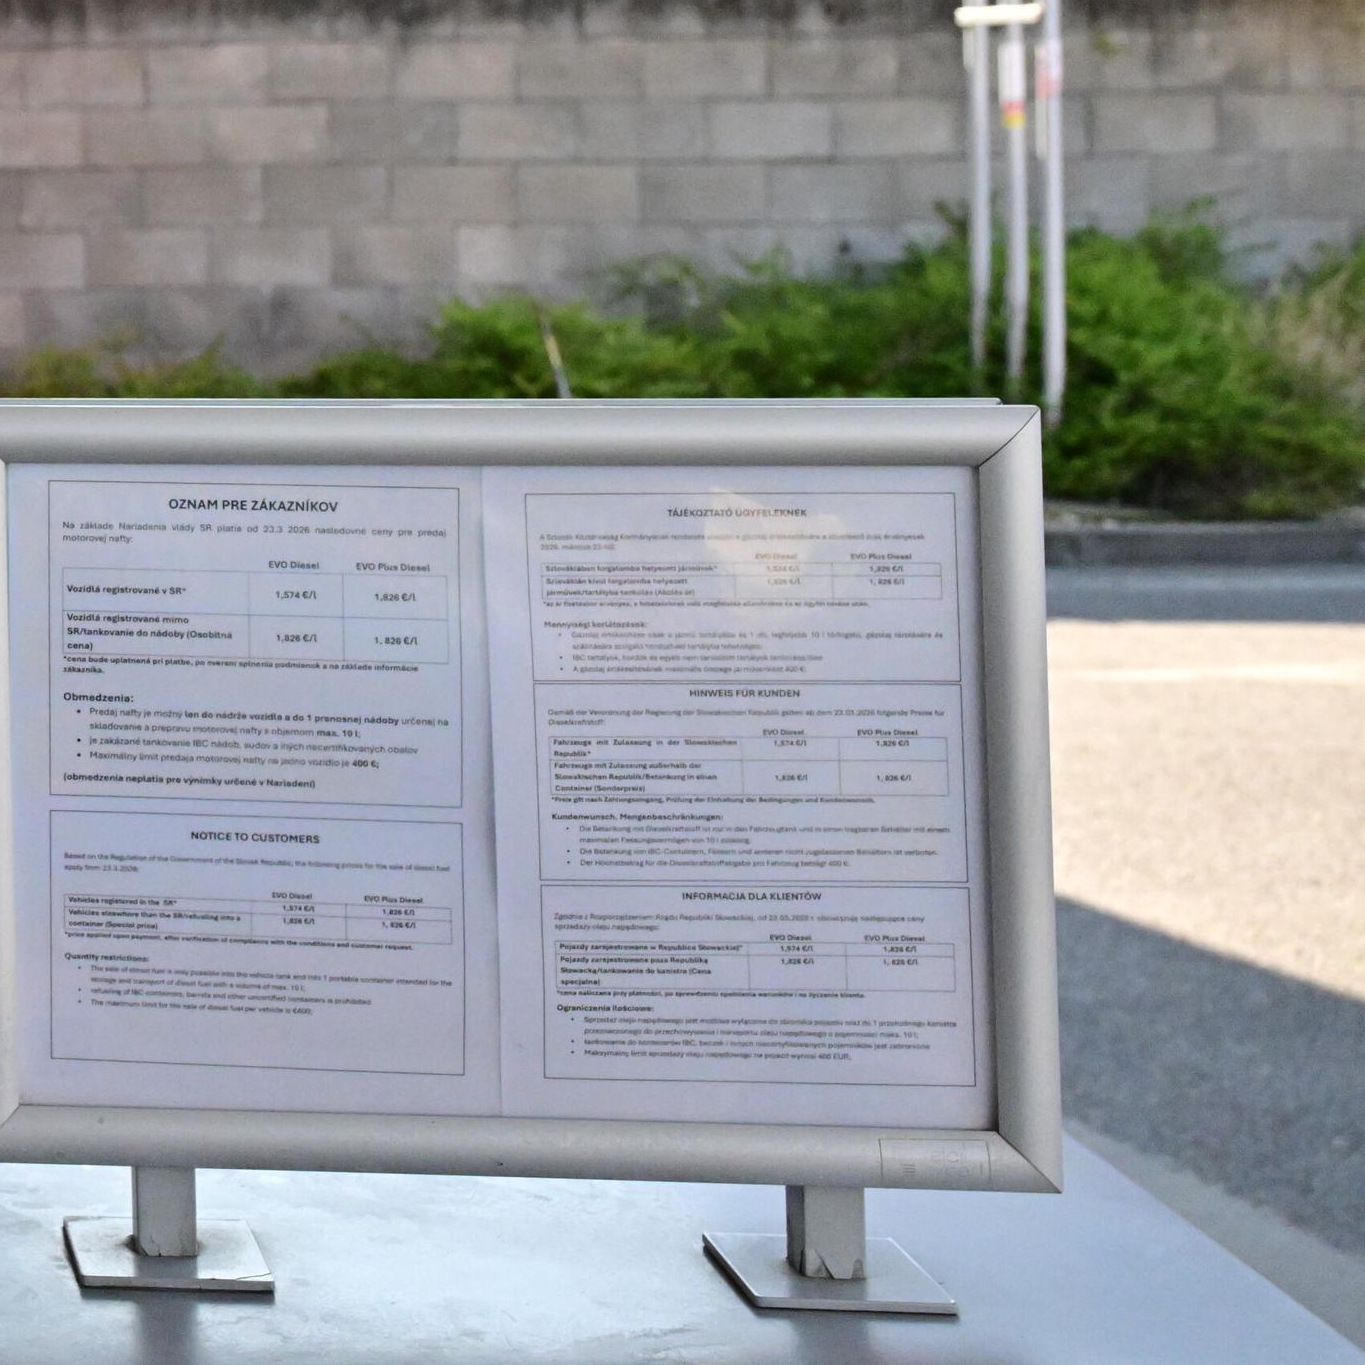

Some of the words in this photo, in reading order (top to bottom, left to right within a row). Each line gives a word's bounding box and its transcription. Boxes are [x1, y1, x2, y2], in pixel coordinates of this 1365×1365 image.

[168, 498, 217, 509] OZNAM
[222, 499, 247, 510] PRE
[251, 498, 337, 511] ZÁKAZNÍKOV
[689, 689, 733, 697] HINWEIS
[735, 689, 755, 697] FÜR
[757, 689, 799, 697] KUNDEN
[190, 831, 231, 841] NOTICE
[234, 832, 248, 841] TO
[251, 833, 319, 843] CUSTOMERS
[682, 892, 745, 900] INFORMACJA
[748, 892, 767, 900] DLA
[769, 891, 821, 900] KLIENTÓW
